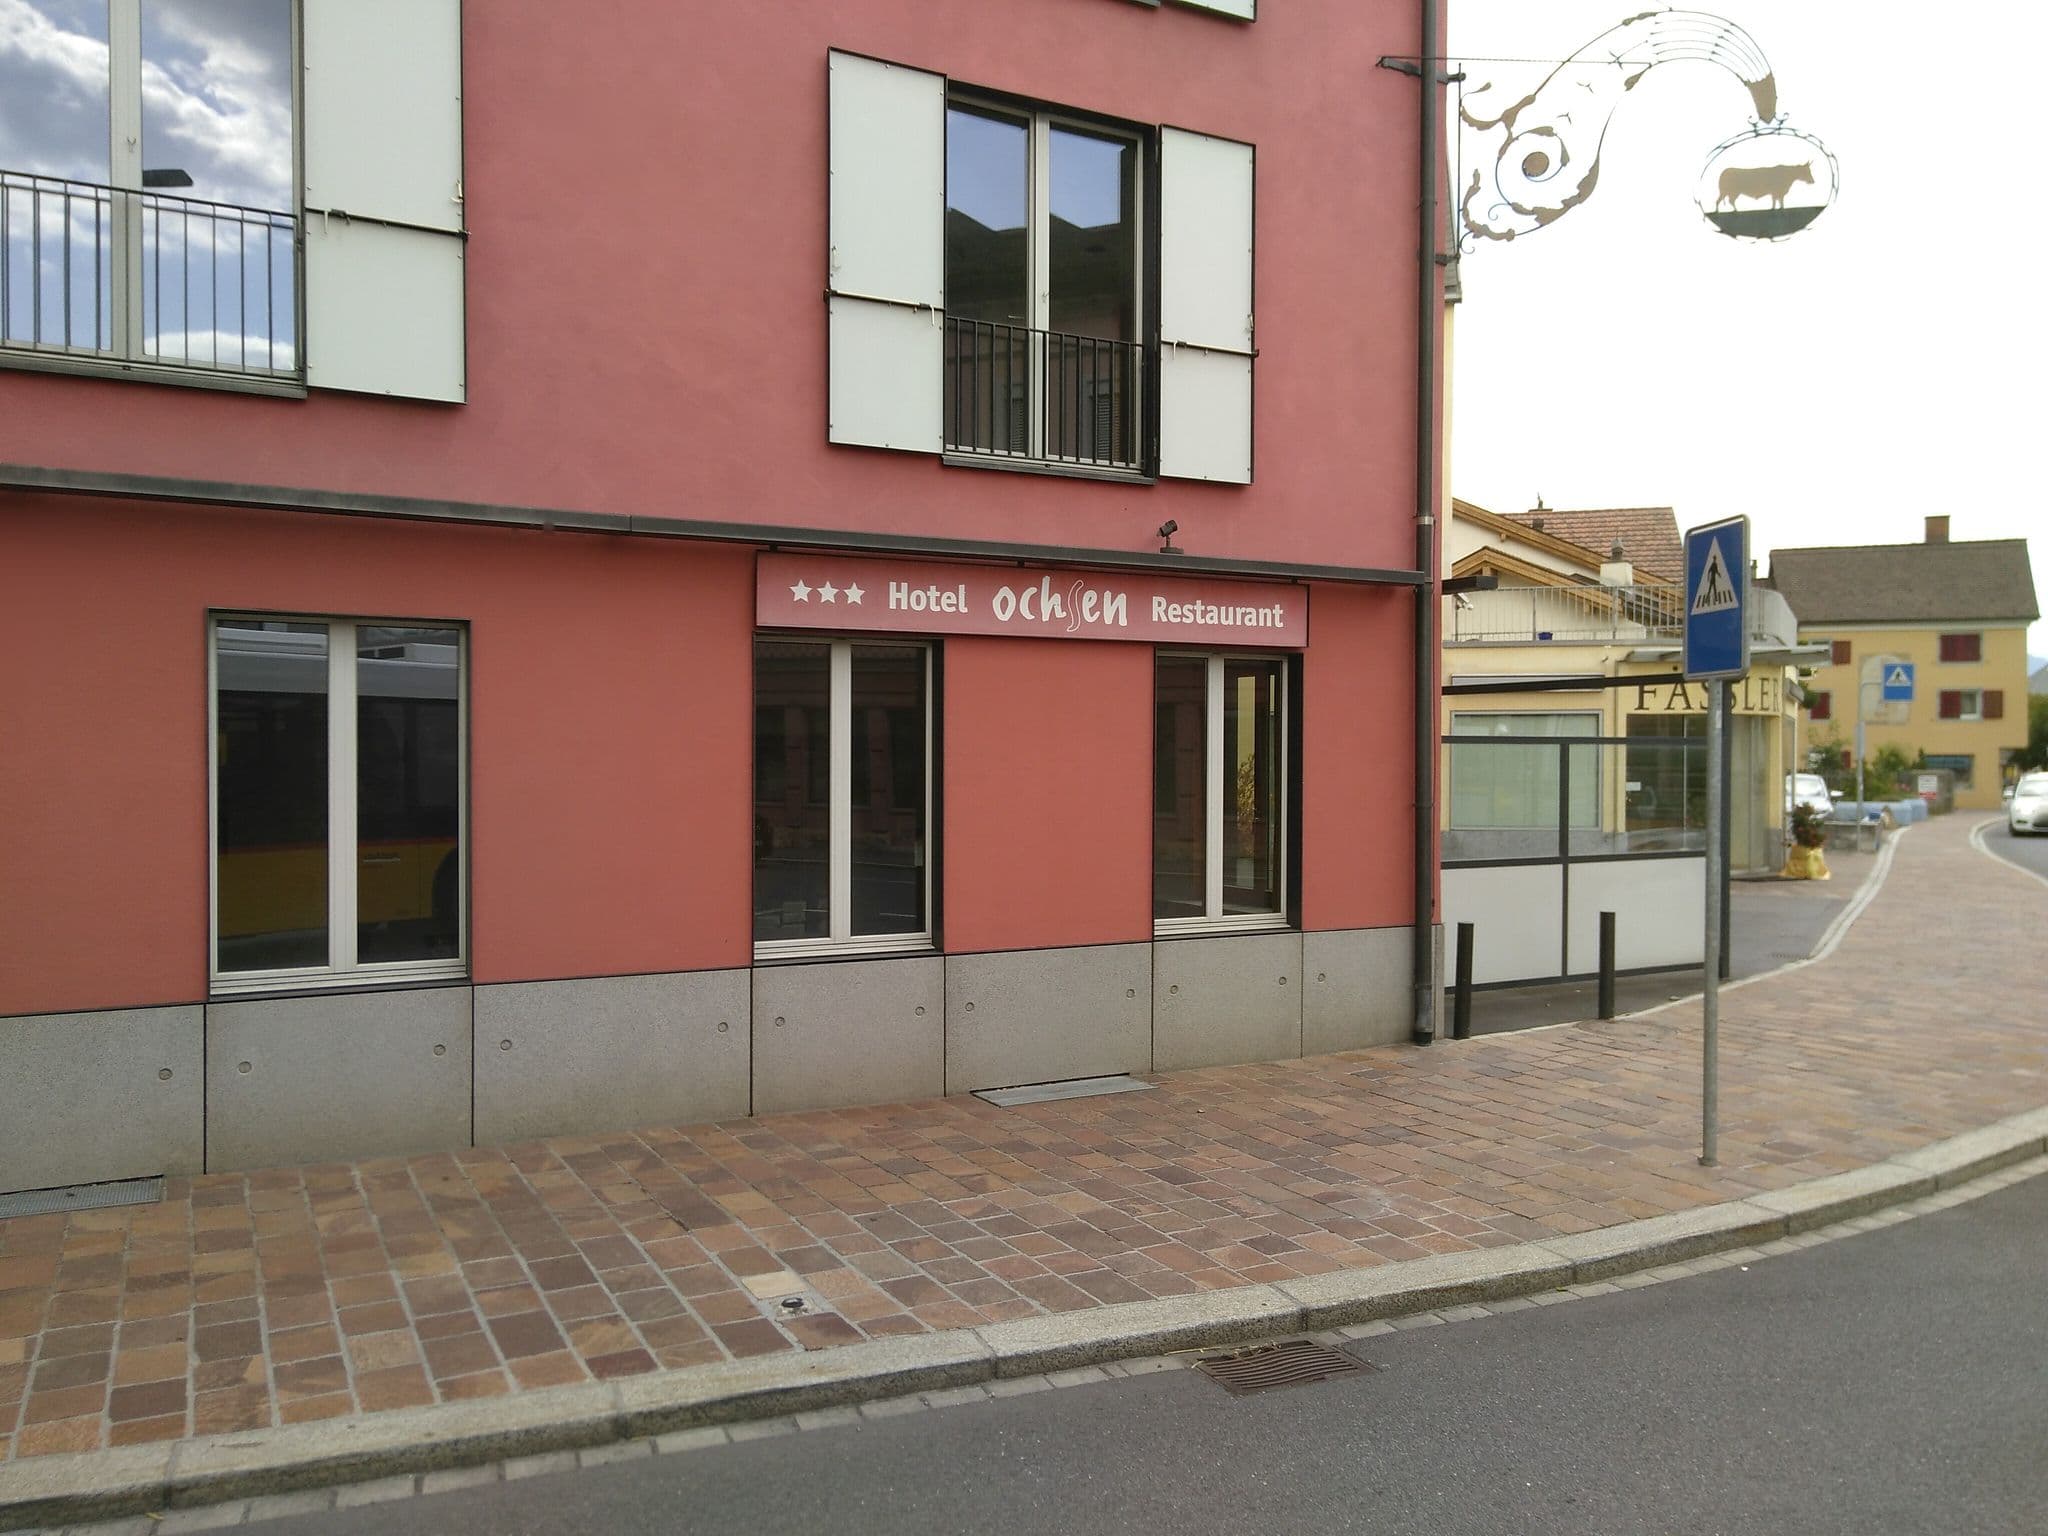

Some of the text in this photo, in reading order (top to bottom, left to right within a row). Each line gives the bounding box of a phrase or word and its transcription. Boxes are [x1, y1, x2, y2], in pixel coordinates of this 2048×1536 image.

[888, 575, 1284, 632] Hotel ochsen Restaurant
